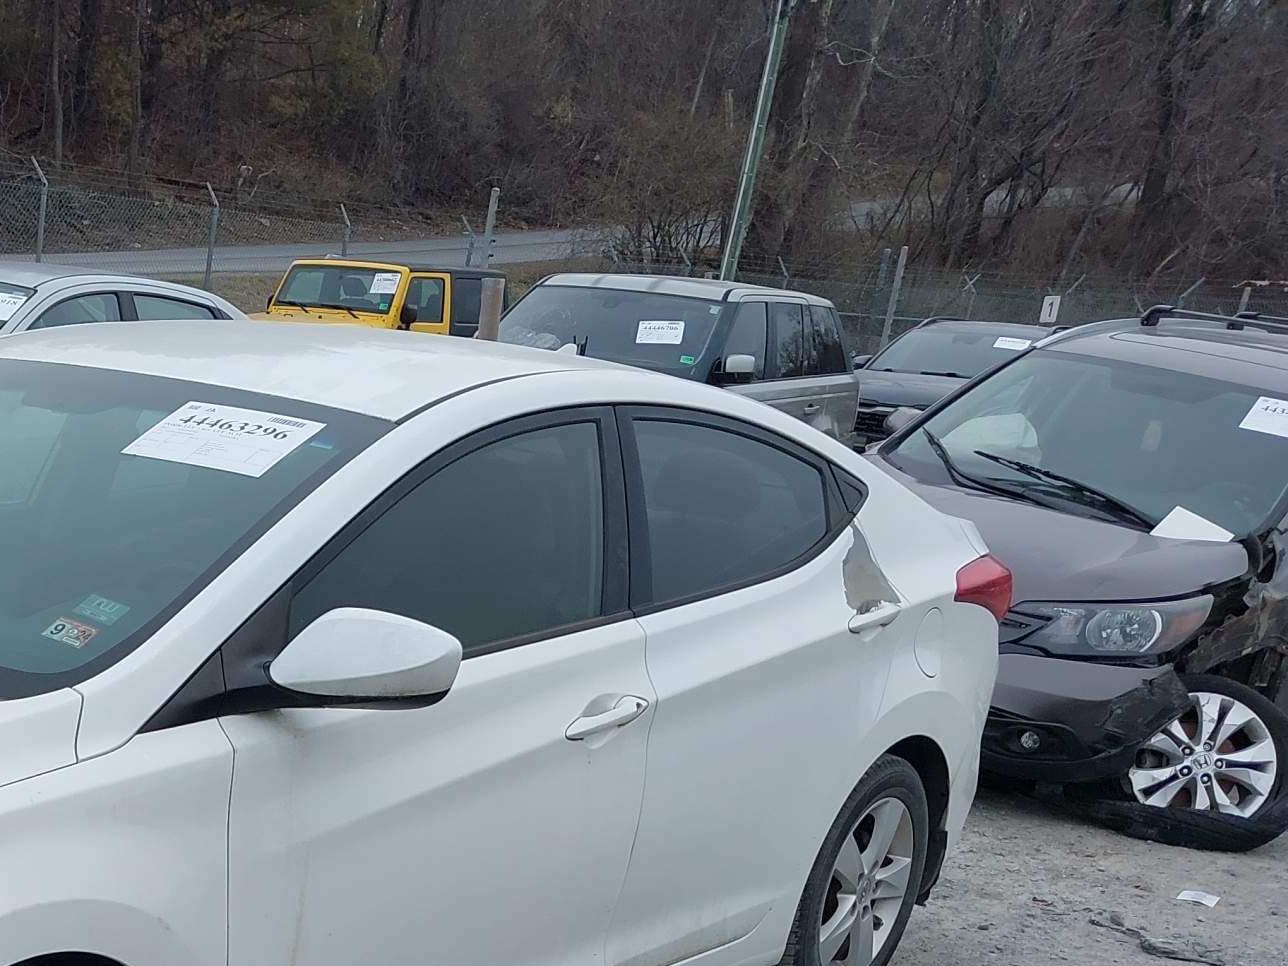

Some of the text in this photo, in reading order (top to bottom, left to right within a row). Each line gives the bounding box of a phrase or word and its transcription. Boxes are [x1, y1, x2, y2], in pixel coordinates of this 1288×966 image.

[1048, 301, 1054, 318] 1
[178, 413, 293, 441] 44463296
[50, 623, 66, 635] 9
